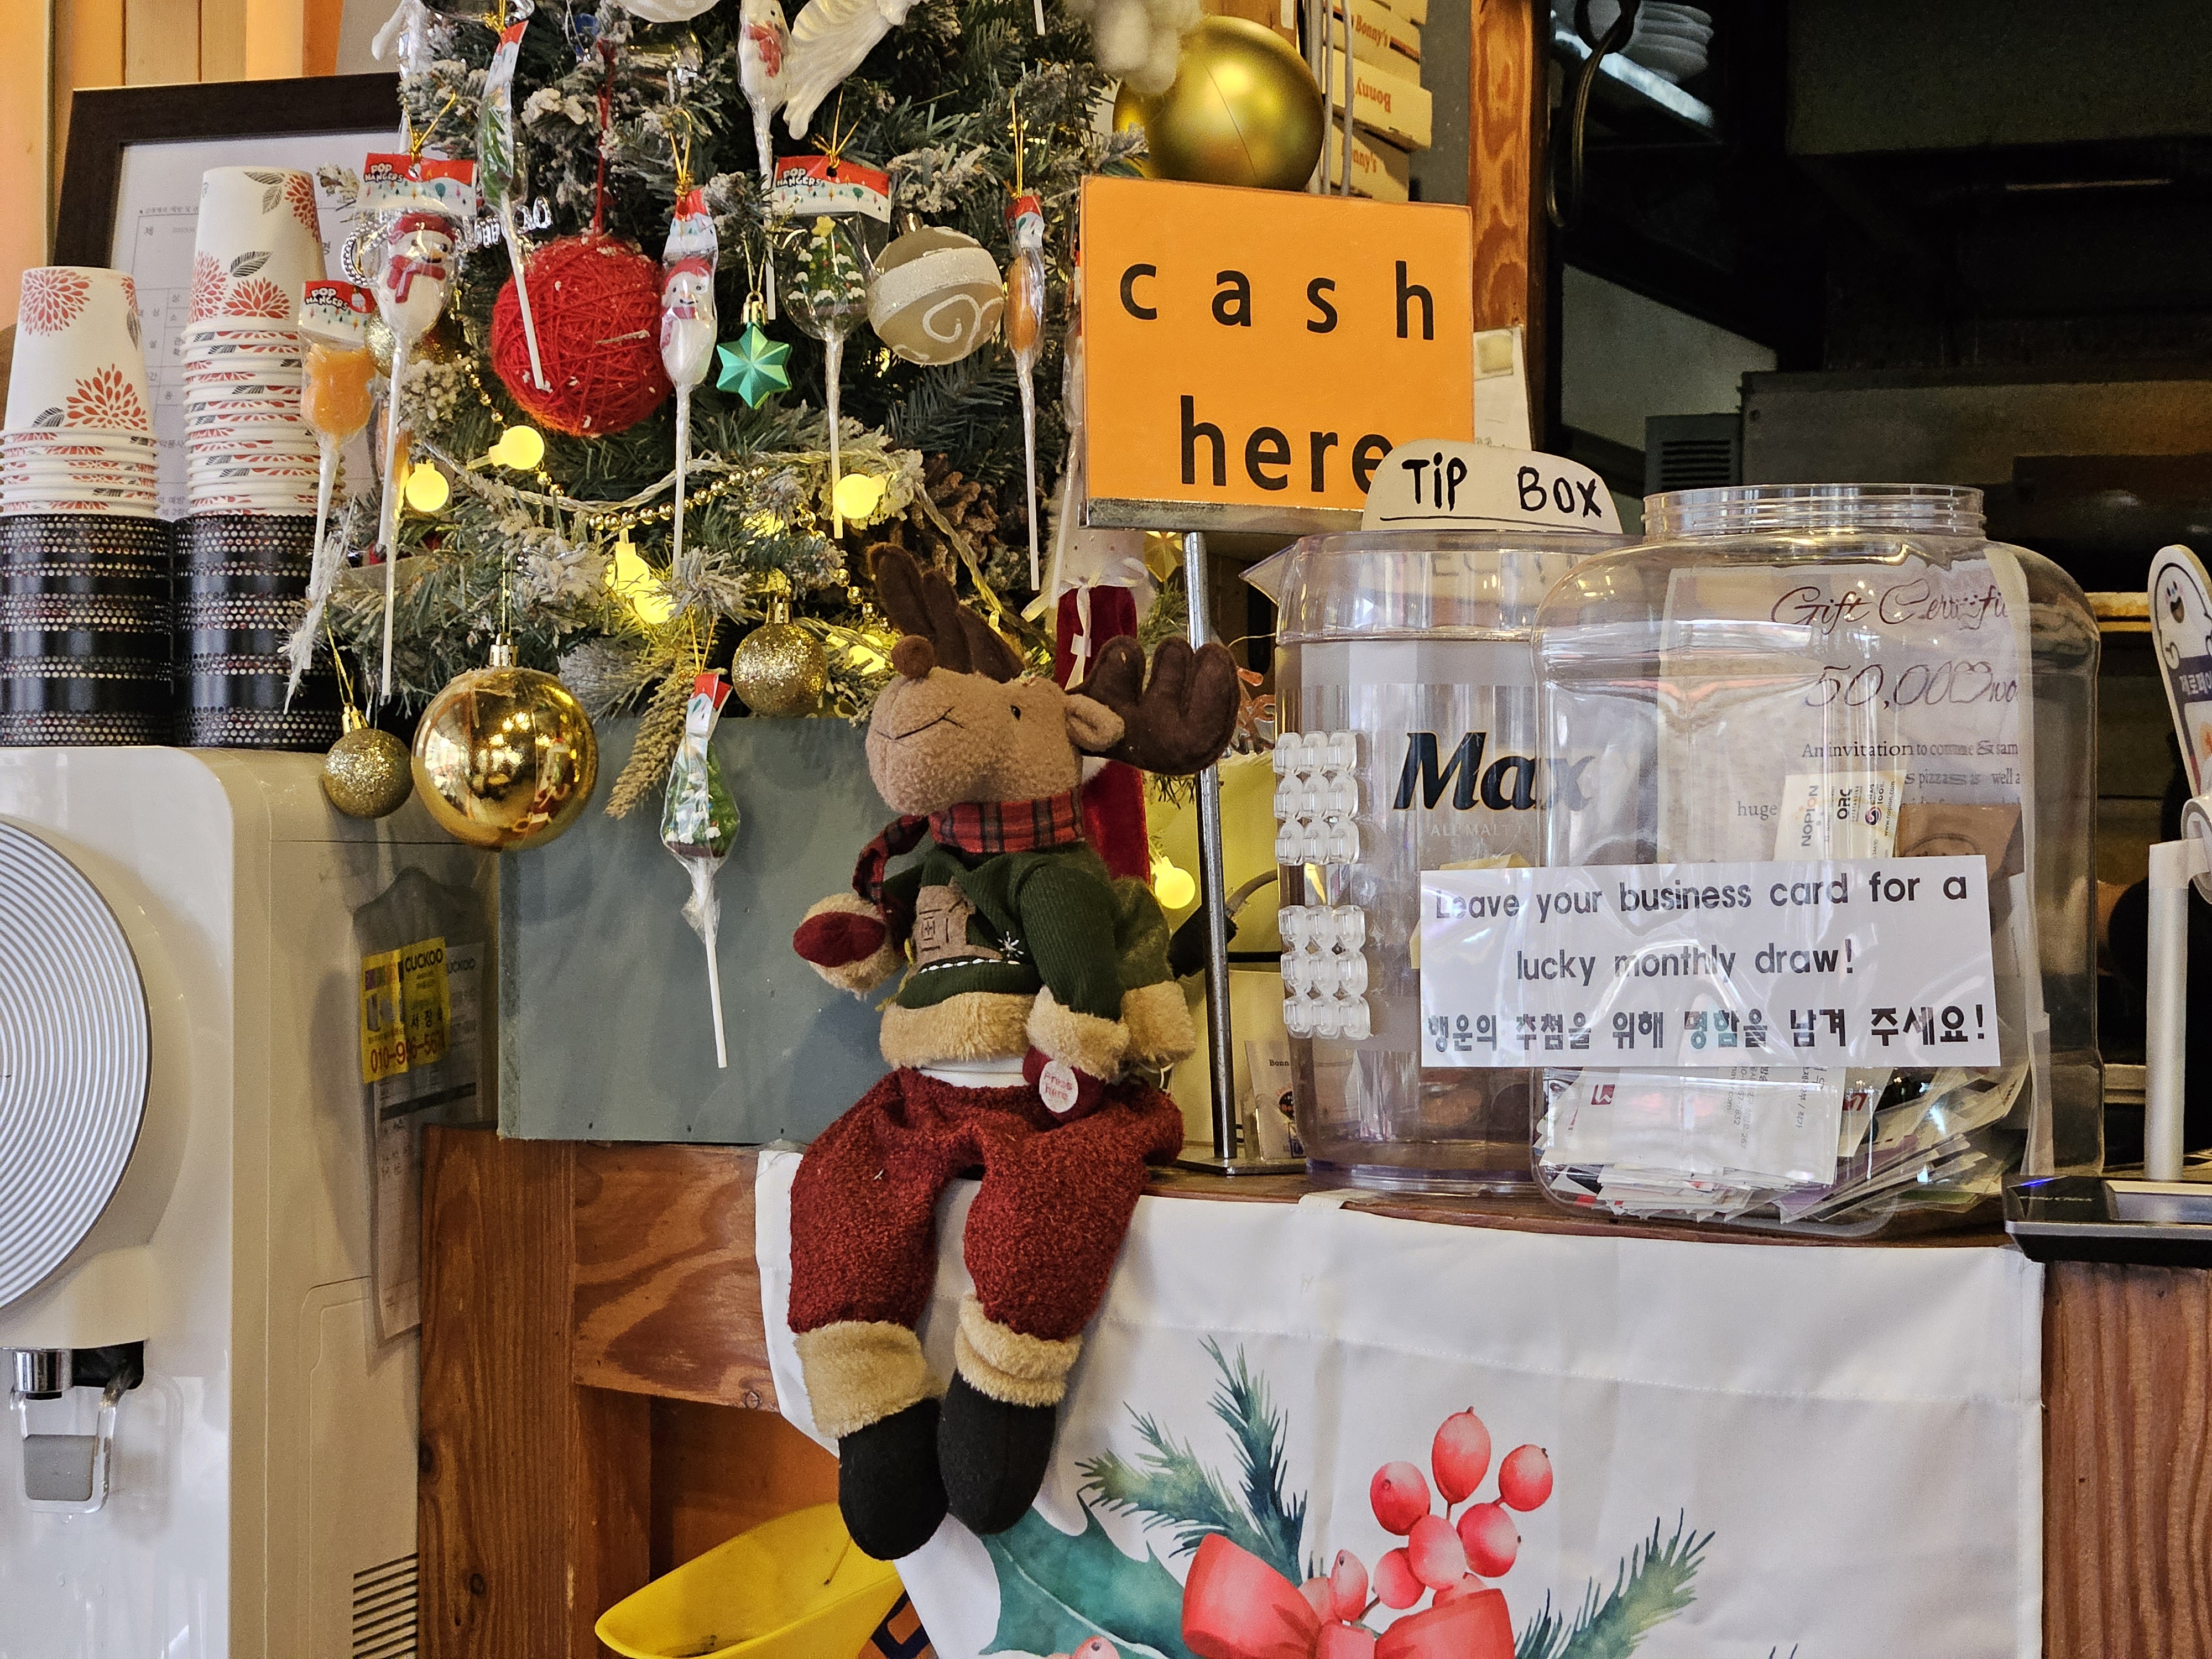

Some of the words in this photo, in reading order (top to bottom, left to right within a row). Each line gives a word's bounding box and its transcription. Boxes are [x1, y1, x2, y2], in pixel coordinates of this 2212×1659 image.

[1356, 14, 1389, 48] Bonny's
[364, 171, 404, 184] HANGERS
[370, 162, 393, 174] POP
[782, 167, 807, 180] POP
[776, 176, 822, 188] HANGERS
[305, 296, 349, 311] HANGERS
[310, 286, 338, 299] POP
[1120, 260, 1434, 341] cash
[1771, 586, 1873, 635] Gift
[1828, 741, 1914, 758] invitation
[1392, 731, 1596, 811] Max
[1736, 801, 1778, 820] huge
[1801, 785, 1819, 847] NOPION
[1435, 889, 1520, 919] Leave
[1536, 889, 1604, 924] your
[1620, 879, 1752, 912] business
[1770, 873, 1849, 907] card
[1869, 871, 1920, 902] for
[1943, 876, 1968, 900] a
[405, 947, 443, 973] CUCKOO
[1517, 949, 1597, 987] lucky
[1614, 945, 1736, 978] monthly
[1754, 938, 1853, 974] draw!
[1428, 1014, 1498, 1052] 행운의
[1516, 1011, 1592, 1051] 추첨을
[1612, 1011, 1663, 1050] 위해
[1684, 1008, 1768, 1050] 명함을
[1790, 1008, 1846, 1047] 남겨
[1871, 1004, 1985, 1047] 주세요!
